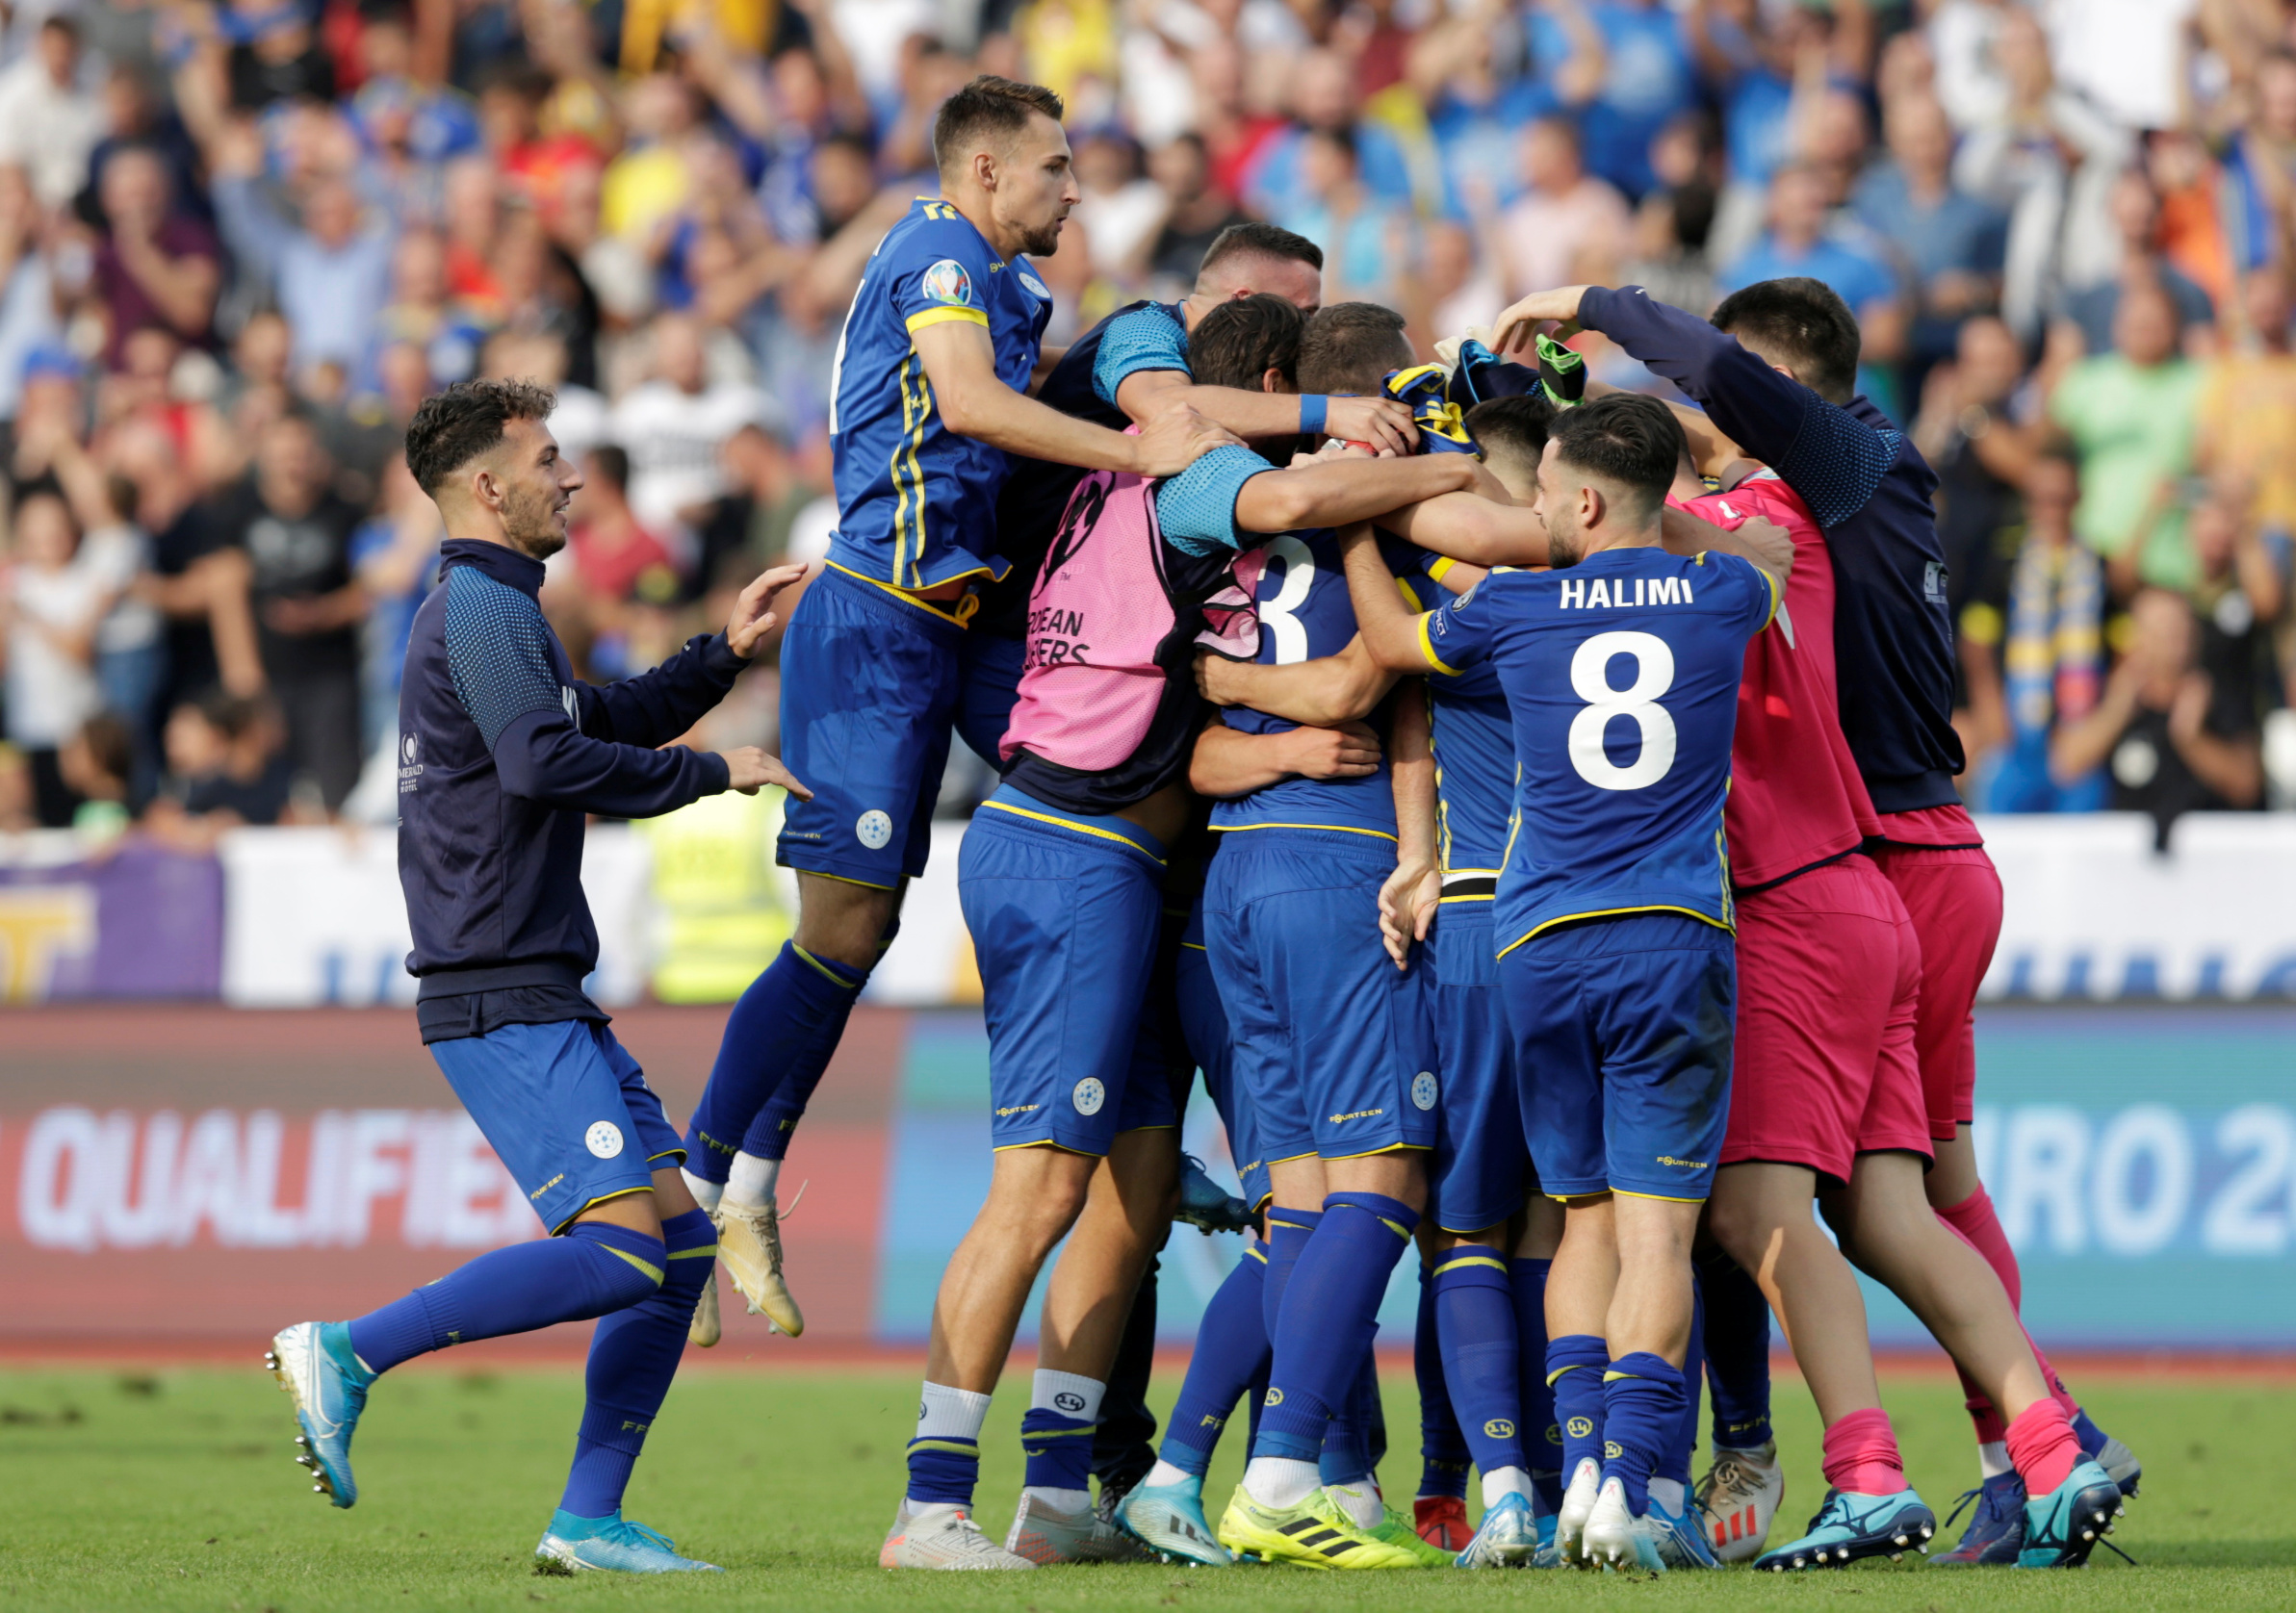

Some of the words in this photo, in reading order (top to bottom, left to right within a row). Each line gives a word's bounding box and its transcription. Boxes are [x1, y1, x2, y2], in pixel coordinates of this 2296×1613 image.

[1257, 535, 1315, 665] 3
[1560, 576, 1693, 609] HALIMI
[1568, 630, 1677, 791] 8
[1329, 1109, 1383, 1124] FOURTEEN
[1657, 1156, 1708, 1168] FOURTEEN
